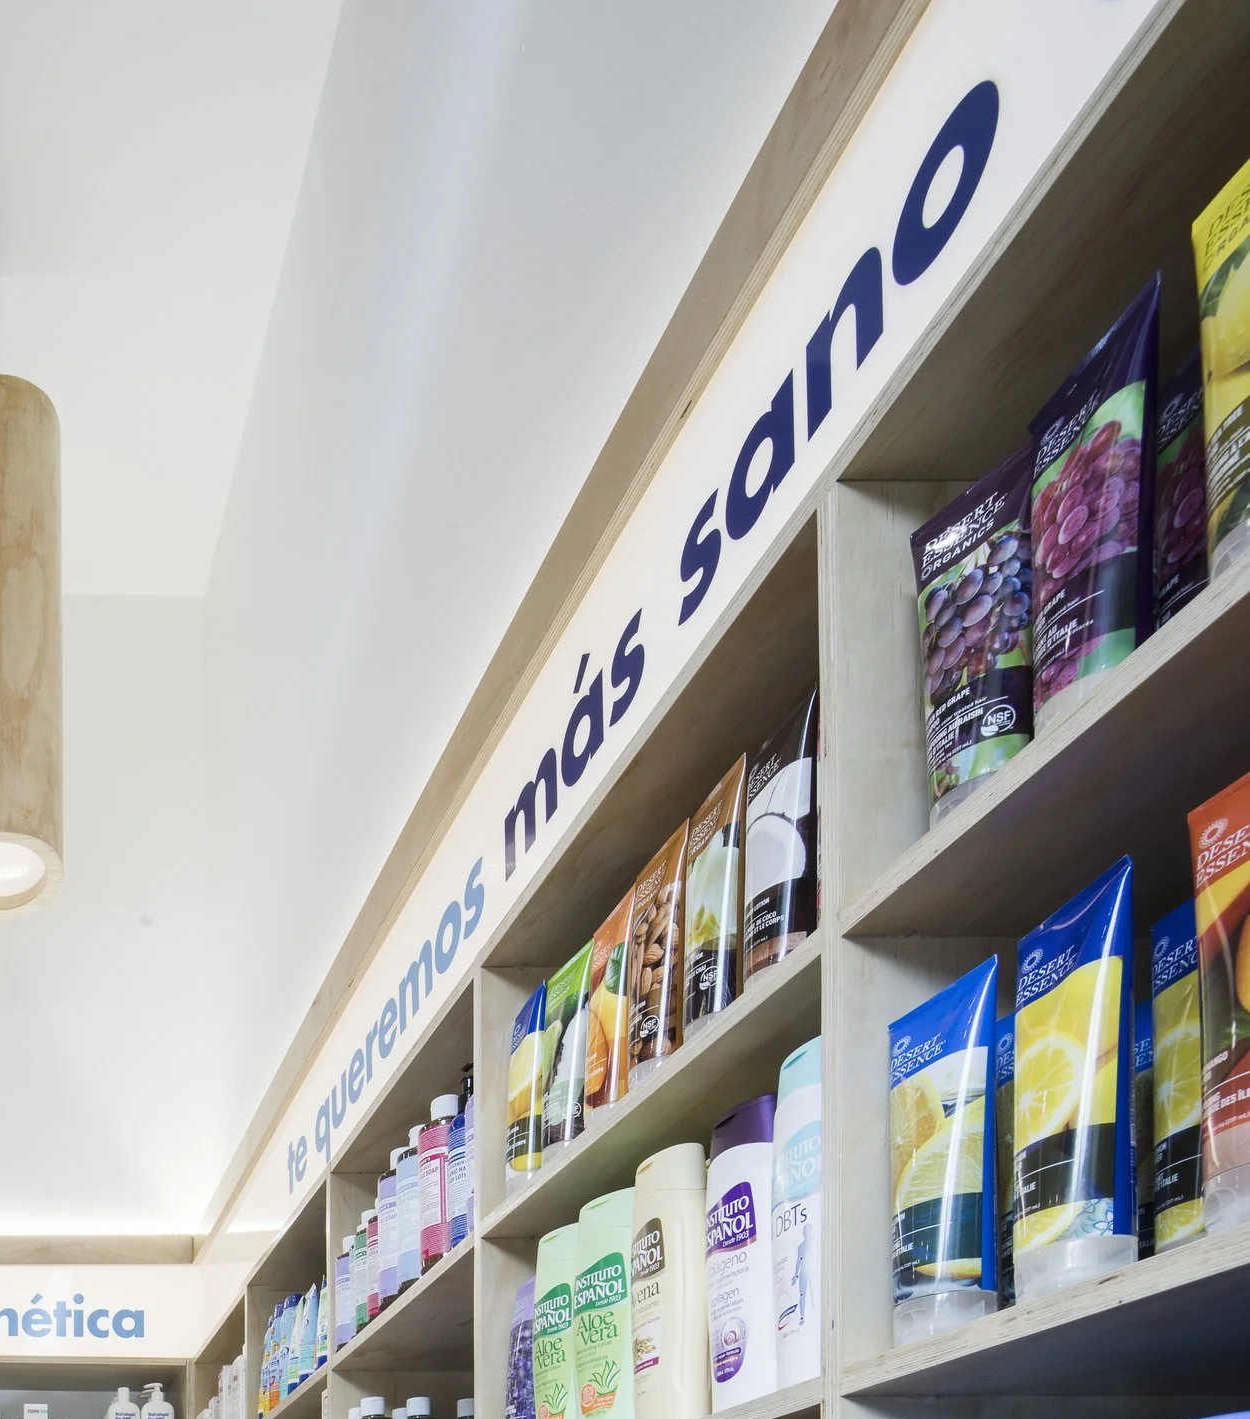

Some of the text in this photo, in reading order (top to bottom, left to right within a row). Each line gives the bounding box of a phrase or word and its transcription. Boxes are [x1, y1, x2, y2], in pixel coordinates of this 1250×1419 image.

[921, 518, 994, 580] ORGANICS
[288, 80, 1000, 1194] te queremos más sano
[947, 687, 971, 708] GRAPE
[987, 710, 1011, 726] NSF
[1196, 824, 1250, 871] DESE
[1015, 953, 1076, 1005] ESSENCE
[1017, 945, 1076, 992] DESERT
[425, 1166, 438, 1176] SOAP
[775, 1203, 808, 1238] DBTs
[722, 1230, 749, 1248] Desde 1903
[575, 1264, 622, 1292] INSTITUTO
[573, 1277, 625, 1310] ESPAÑOL
[577, 1311, 615, 1335] Aloe
[536, 1337, 563, 1358] Aloe
